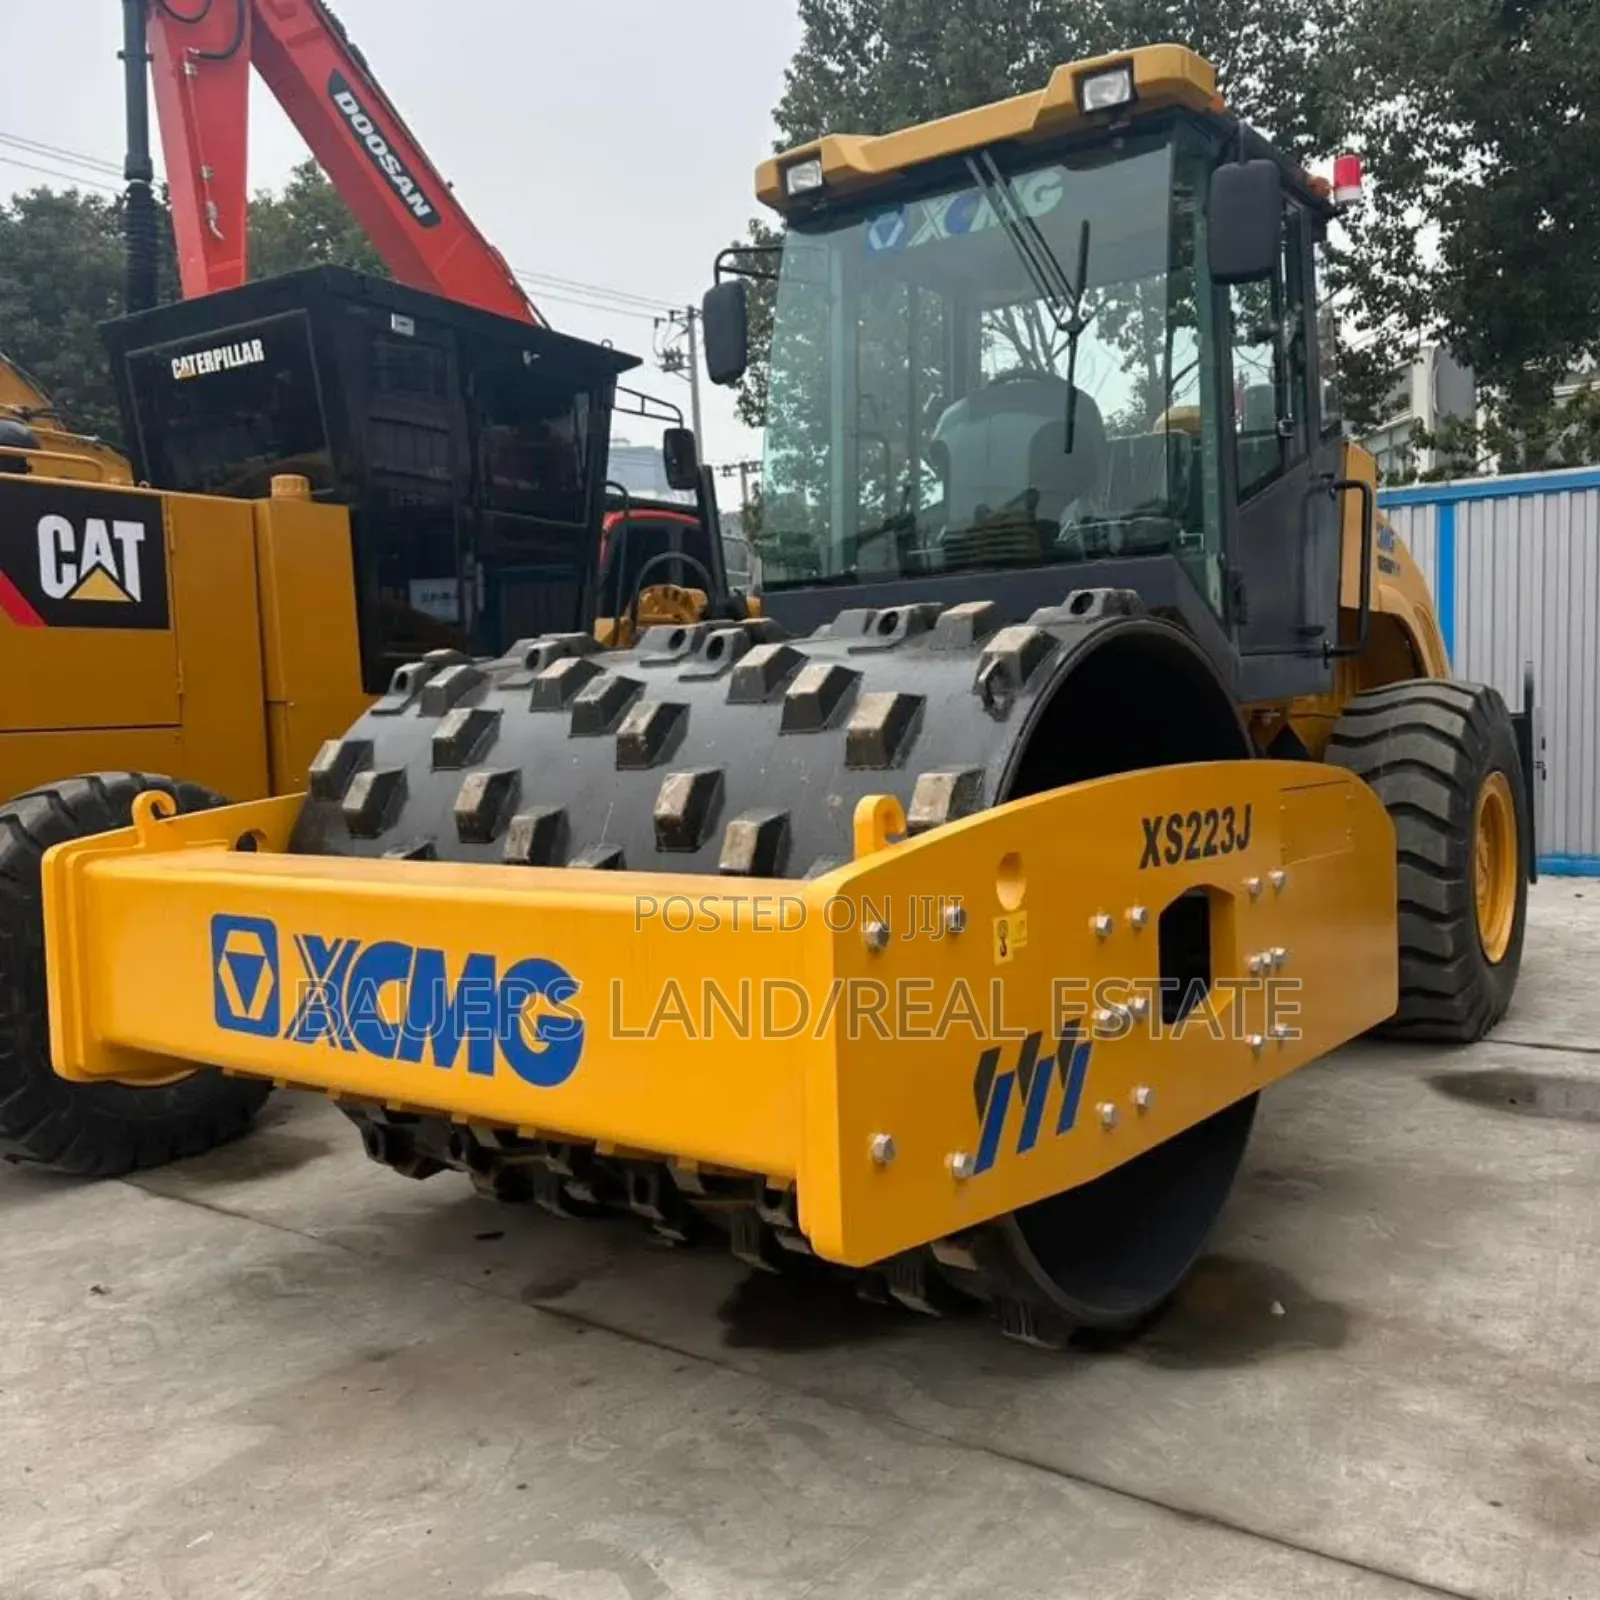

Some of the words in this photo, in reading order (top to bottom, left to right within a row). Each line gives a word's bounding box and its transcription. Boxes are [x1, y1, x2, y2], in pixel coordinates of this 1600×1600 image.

[334, 90, 432, 217] DOOSAN
[171, 338, 265, 380] CATERPILLAR
[37, 514, 145, 602] CAT
[1138, 803, 1252, 870] XS223J
[283, 933, 585, 1087] XCMG
